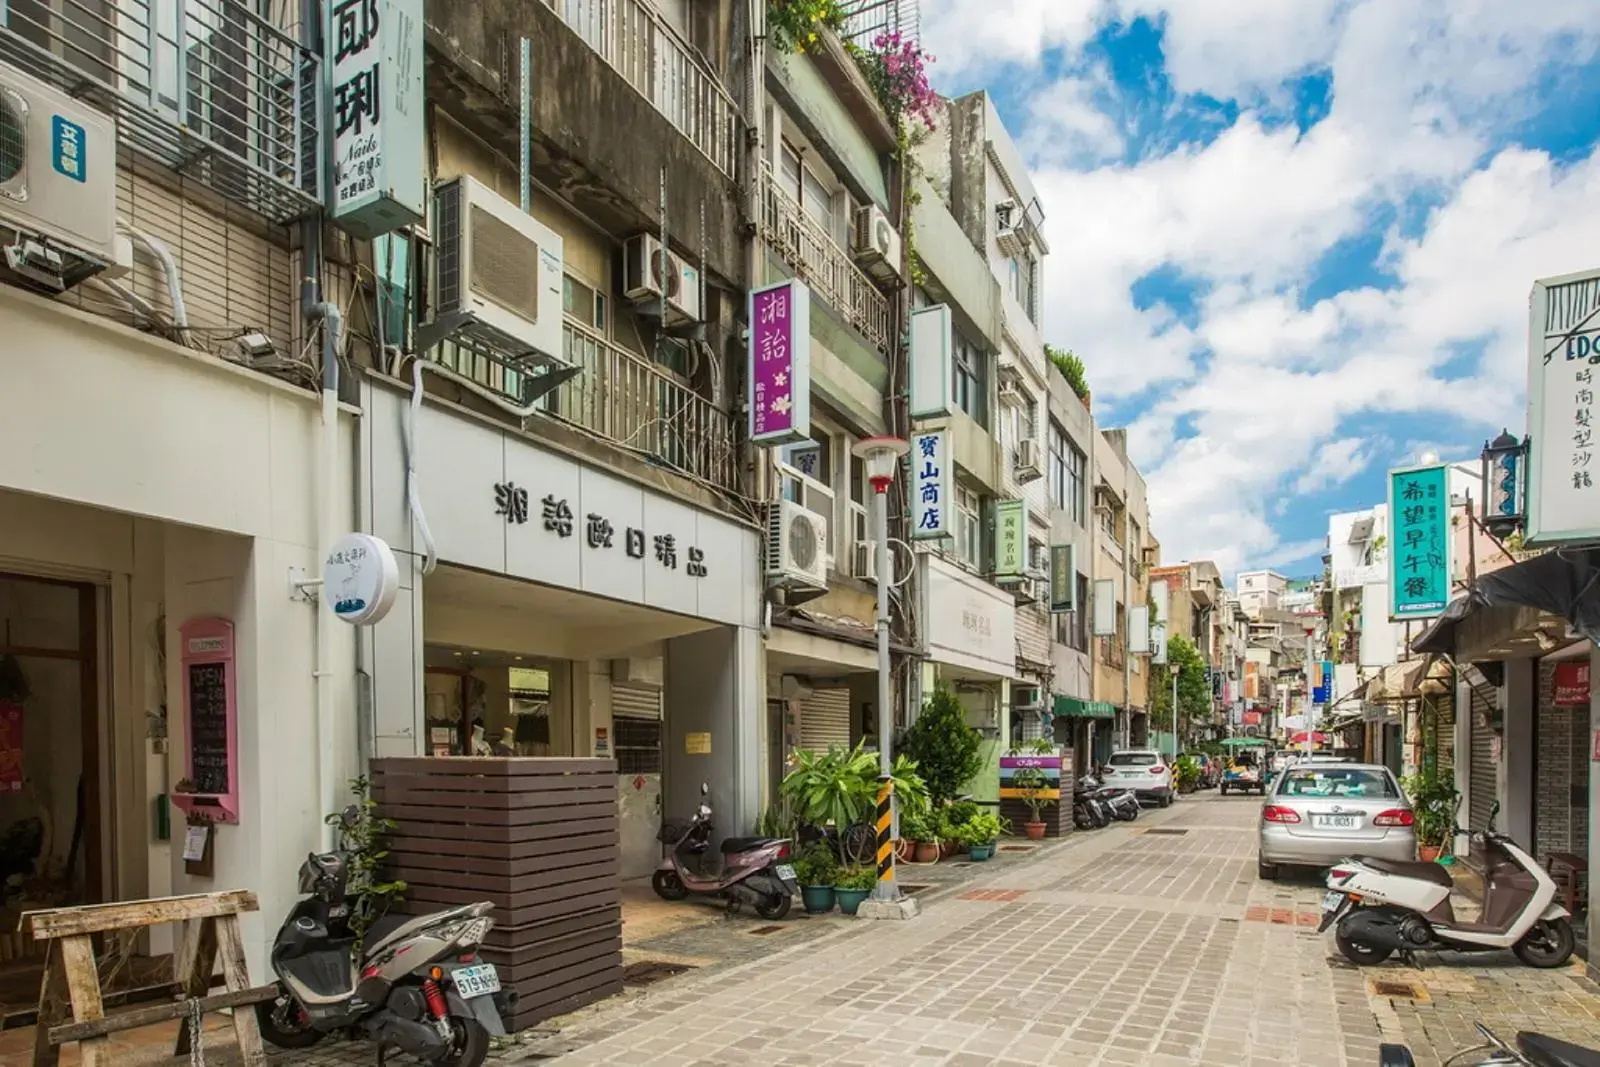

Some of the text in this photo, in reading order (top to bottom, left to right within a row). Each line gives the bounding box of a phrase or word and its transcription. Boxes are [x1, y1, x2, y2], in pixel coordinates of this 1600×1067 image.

[761, 292, 786, 362] 湘詒
[1572, 368, 1594, 489] 時尚髮型沙龍
[494, 481, 708, 577] 湘詒歐日精品
[919, 435, 940, 529] 寶山商店
[1402, 480, 1429, 598] 希望早午餐
